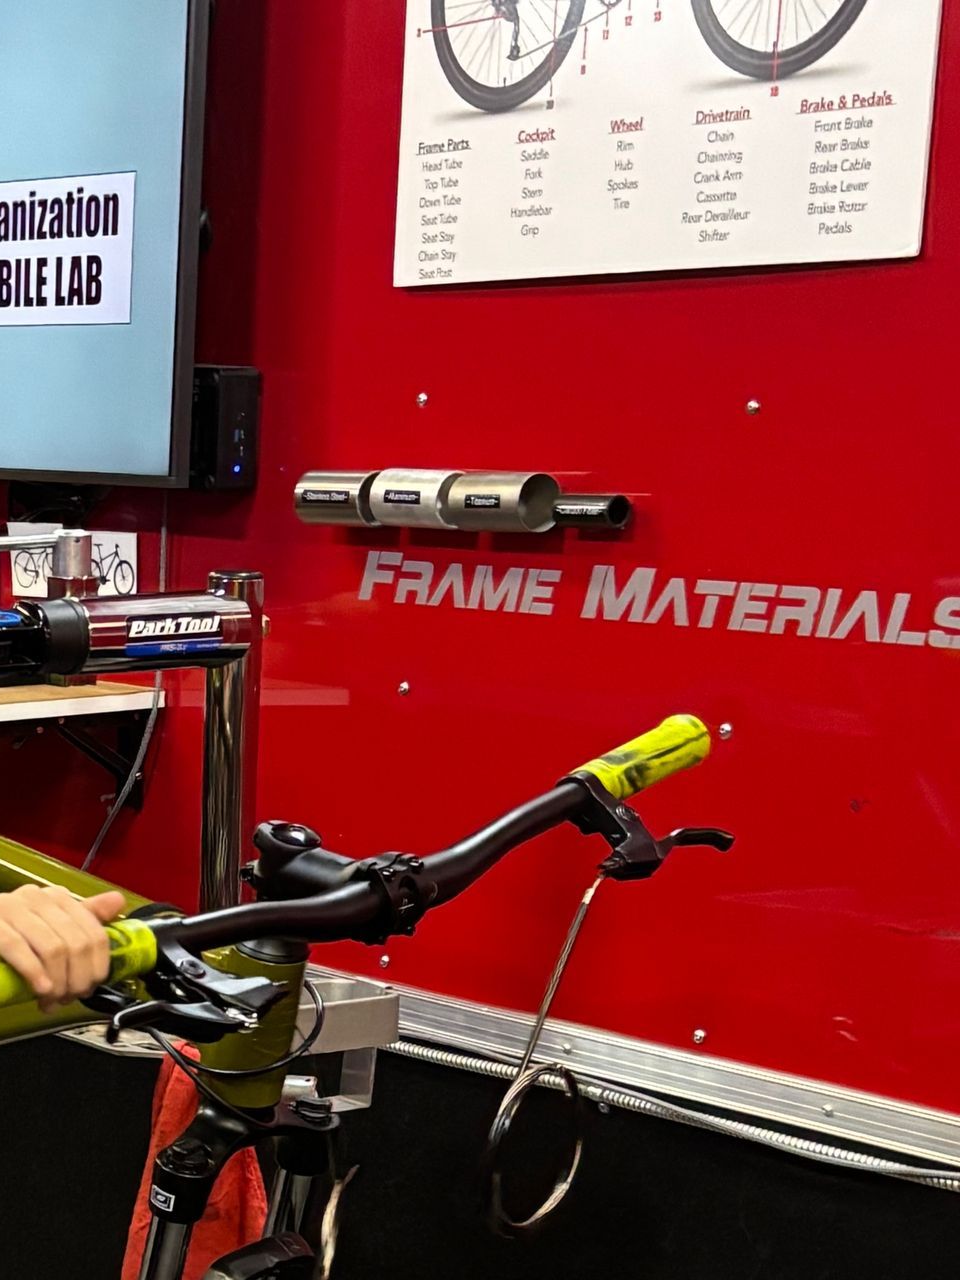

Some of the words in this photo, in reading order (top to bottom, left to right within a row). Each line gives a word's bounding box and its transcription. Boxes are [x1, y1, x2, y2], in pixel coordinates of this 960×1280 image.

[799, 97, 834, 114] Brake
[838, 95, 848, 110] &
[851, 90, 893, 108] Pedals
[695, 106, 751, 125] Drivetrain
[610, 116, 644, 134] Wheel
[517, 127, 556, 144] Cockpit
[707, 130, 734, 143] Chain
[418, 141, 445, 155] Frame
[447, 138, 470, 152] Parts
[616, 140, 634, 152] Rim
[520, 148, 549, 162] Saddle
[422, 161, 442, 172] Head
[444, 158, 463, 170] Tube
[614, 158, 634, 172] Hub
[693, 170, 720, 184] Crank
[424, 178, 438, 192] Top
[440, 177, 460, 188] Tube
[418, 196, 440, 208] Down
[442, 194, 462, 206] Tube
[612, 198, 630, 210] Tire
[510, 204, 552, 218] Handlebar
[704, 208, 751, 223] Derailleur
[439, 213, 458, 224] Tube
[520, 224, 540, 238] Grip
[818, 220, 853, 235] Pedals
[438, 230, 455, 244] Stay
[440, 248, 456, 262] Stay
[54, 254, 102, 306] LAB
[358, 550, 562, 616] FRAME
[580, 565, 960, 649] MATERIALS
